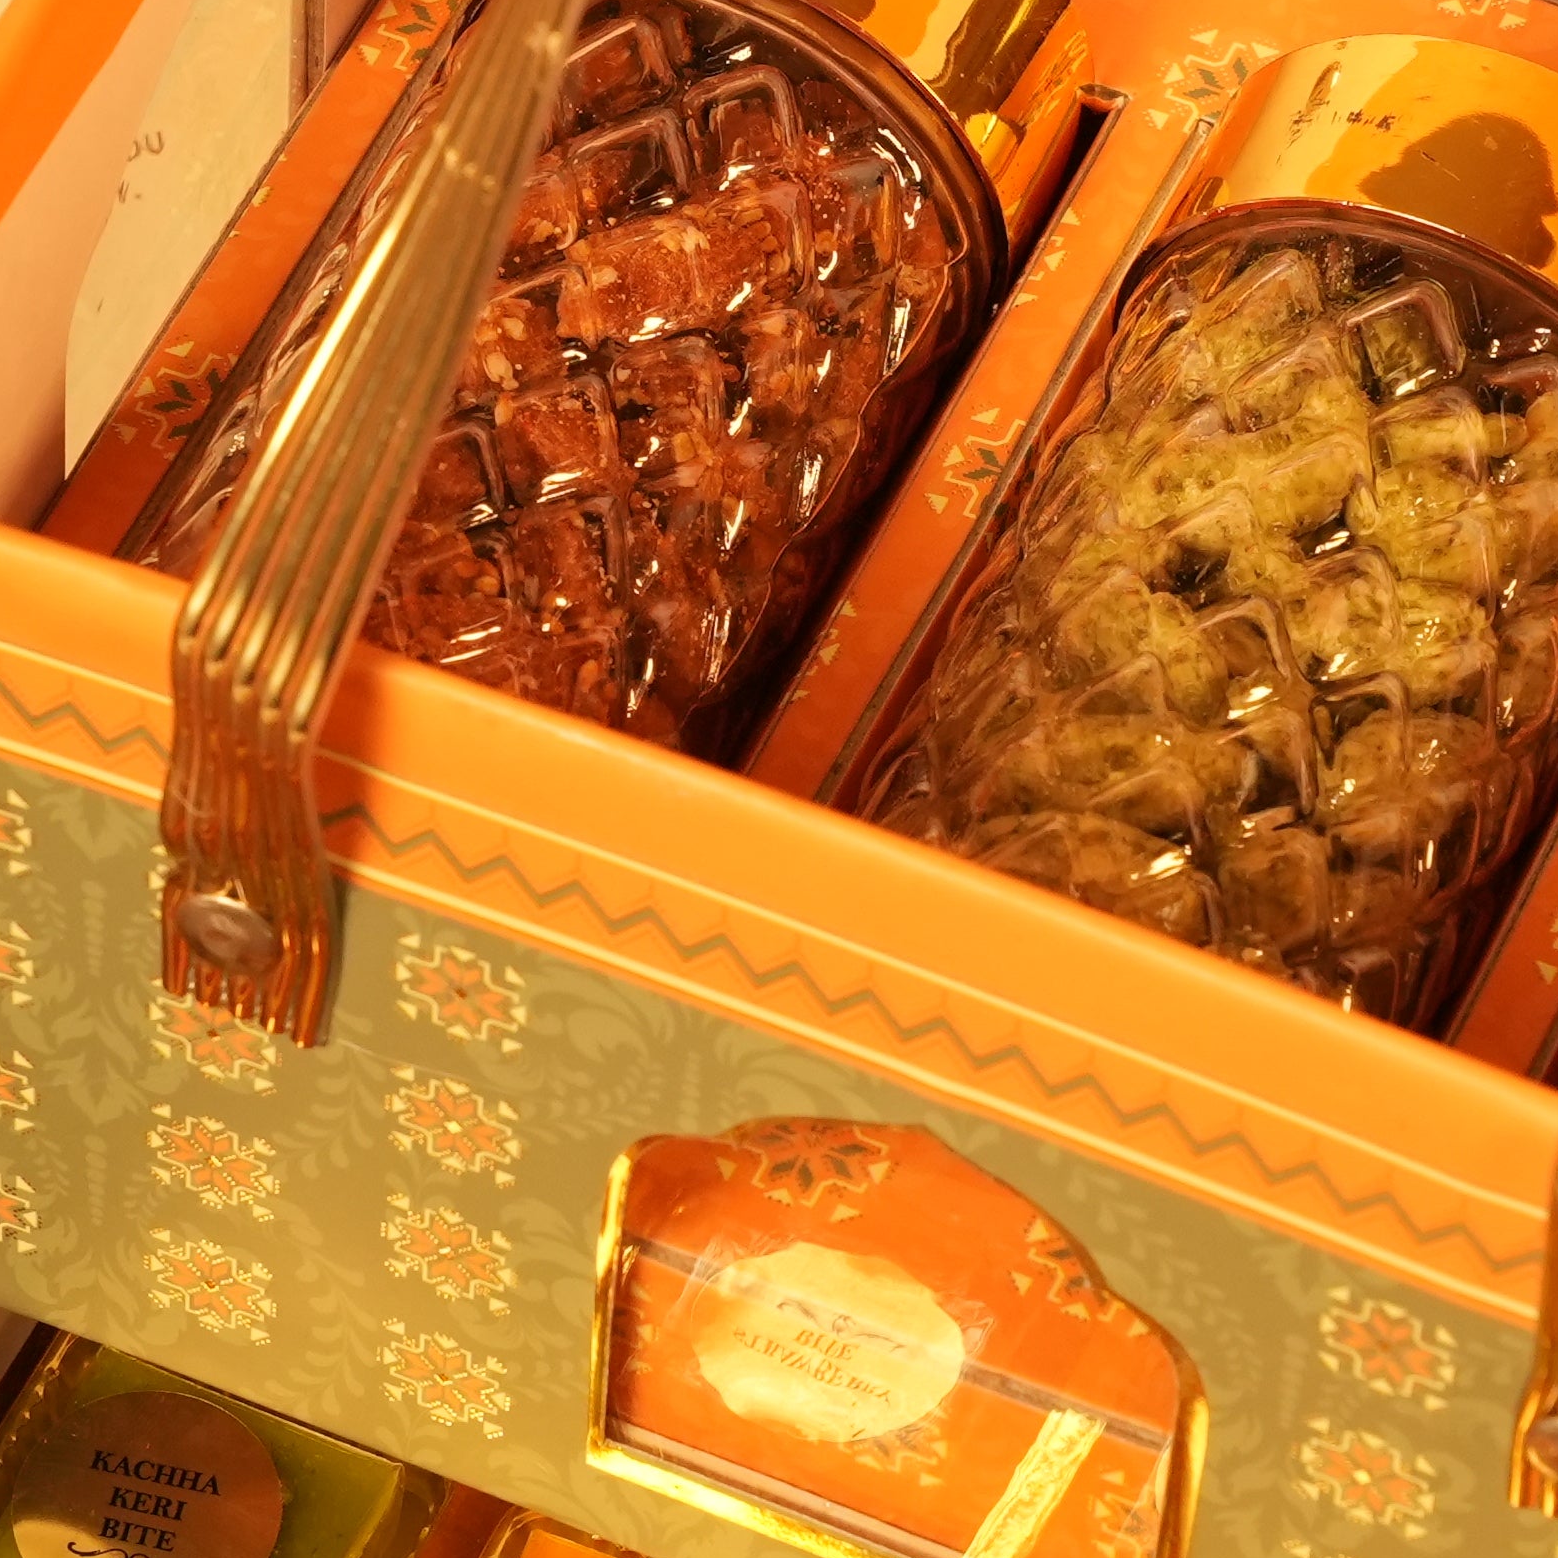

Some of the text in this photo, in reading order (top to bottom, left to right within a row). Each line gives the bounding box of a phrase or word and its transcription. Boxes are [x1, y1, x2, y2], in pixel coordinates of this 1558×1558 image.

[90, 1449, 222, 1496] KACHHA
[108, 1486, 188, 1522] KERI
[98, 1517, 177, 1553] BITE
